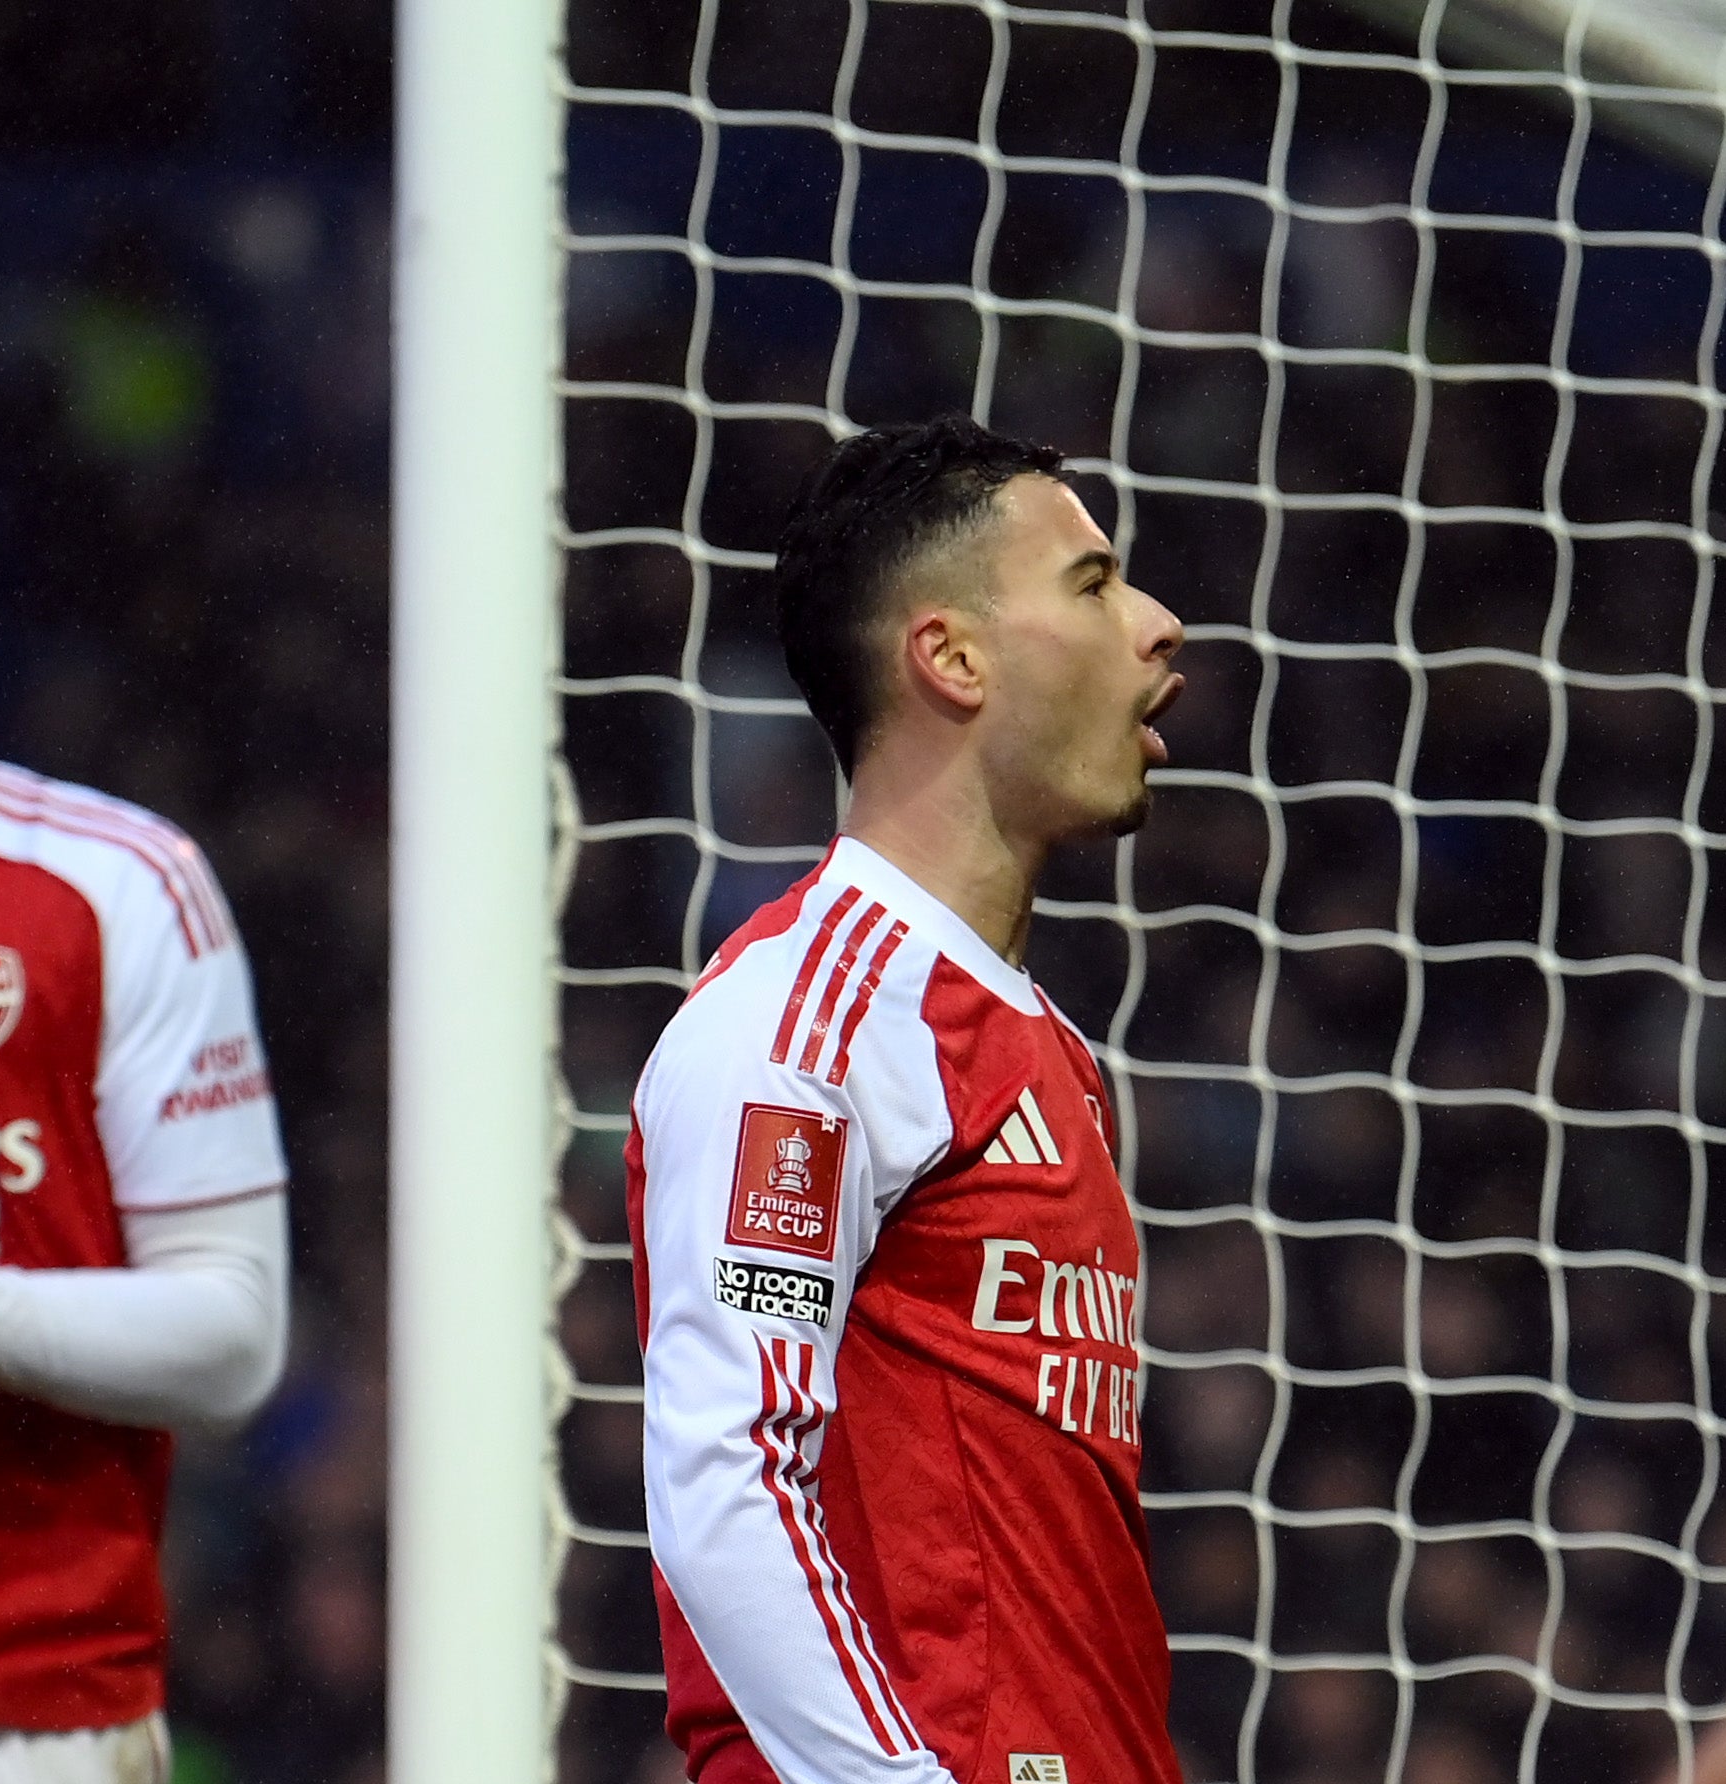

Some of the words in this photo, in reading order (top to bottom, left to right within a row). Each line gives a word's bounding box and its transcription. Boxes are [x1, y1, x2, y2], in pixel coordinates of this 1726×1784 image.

[744, 1210, 772, 1231] FA
[777, 1215, 823, 1239] CUP
[747, 1191, 824, 1219] Emirates
[715, 1259, 750, 1288] No
[753, 1271, 824, 1302] room
[715, 1279, 748, 1309] for
[750, 1292, 830, 1326] racism
[1034, 1353, 1103, 1435] FLY
